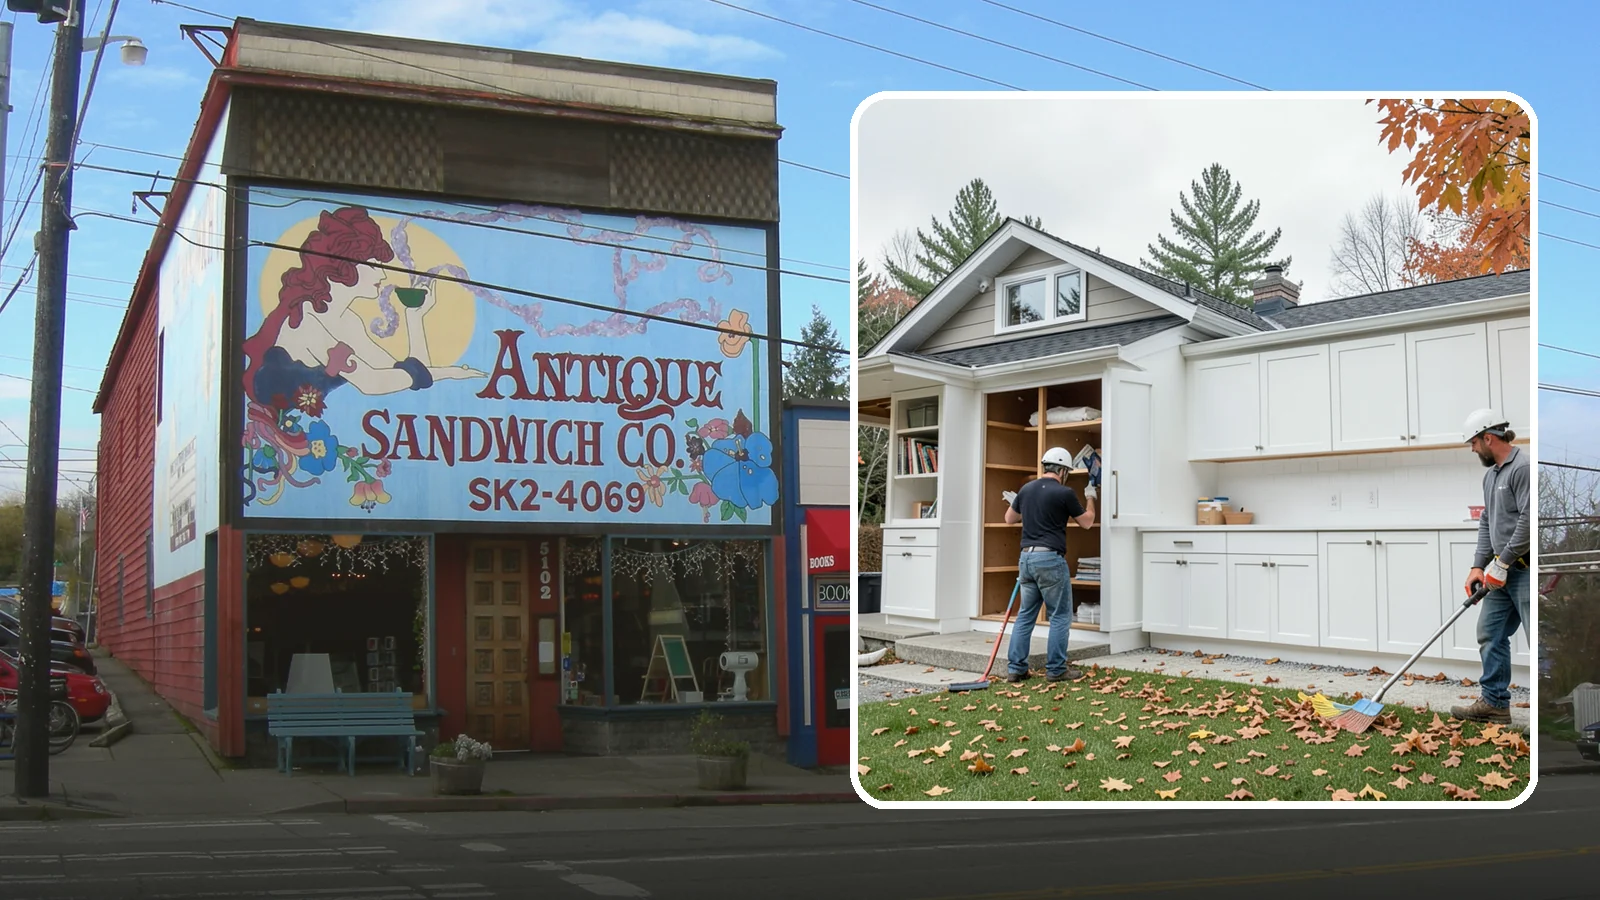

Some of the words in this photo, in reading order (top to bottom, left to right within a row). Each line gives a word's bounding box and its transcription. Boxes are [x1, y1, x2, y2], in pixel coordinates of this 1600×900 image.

[476, 328, 723, 421] ANTIQUE
[361, 408, 604, 468] SANDWICH
[617, 421, 685, 469] CO.
[468, 477, 645, 513] SK2-4069
[540, 541, 552, 600] 5102
[809, 555, 835, 569] BOOKS
